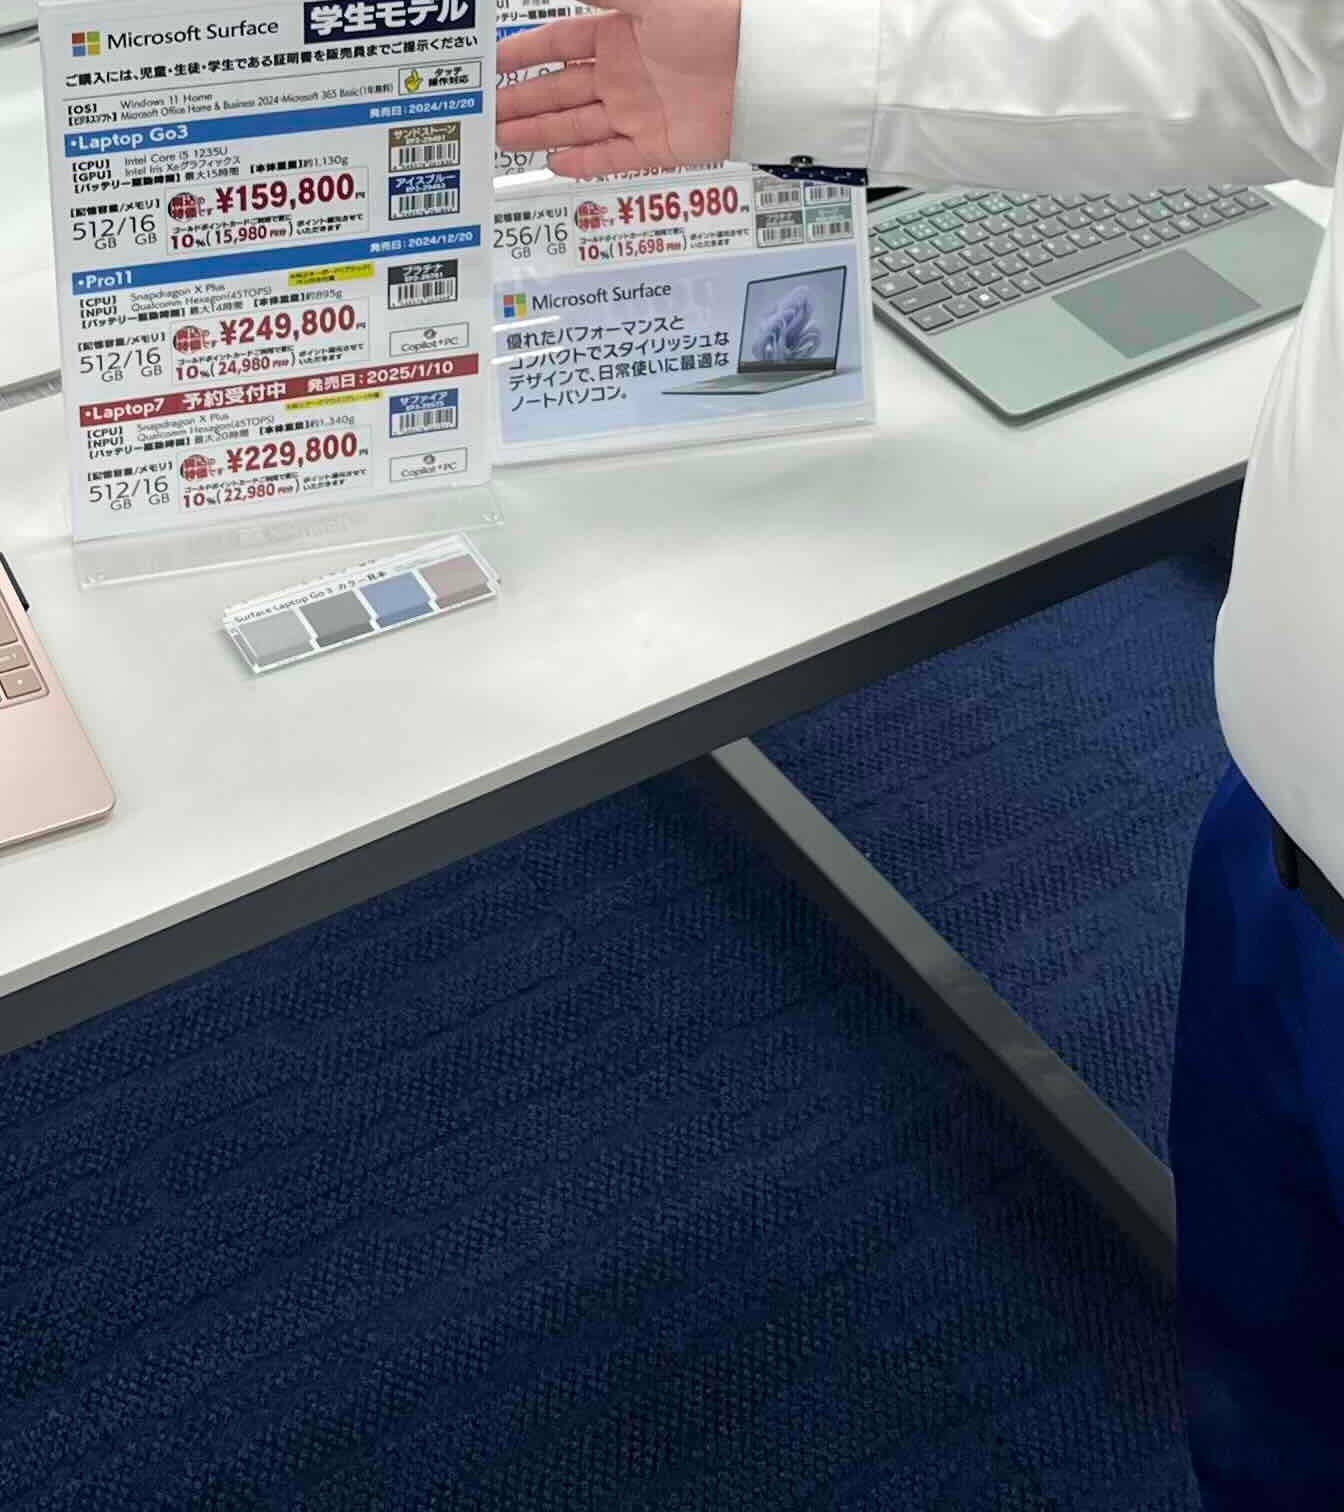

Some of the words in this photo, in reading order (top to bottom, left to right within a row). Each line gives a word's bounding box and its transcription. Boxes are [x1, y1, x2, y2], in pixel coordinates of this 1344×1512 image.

[107, 25, 202, 50] Microsoft
[207, 20, 279, 40] Surface
[120, 97, 165, 110] Windows
[169, 95, 179, 105] 11
[183, 92, 213, 104] Home
[150, 125, 189, 142] Go3
[216, 172, 355, 214] ¥159,800
[617, 185, 739, 224] ¥156,980
[94, 238, 117, 250] GB
[135, 233, 157, 245] GB
[531, 289, 610, 312] Microsoft
[612, 283, 672, 303] Surface
[220, 304, 355, 346] ¥249,800
[506, 315, 685, 350] 優れたパフォーマンスと
[101, 371, 124, 383] GB
[141, 366, 162, 377] GB
[182, 383, 287, 411] 予約受付中
[226, 431, 358, 473] ¥229,800
[110, 500, 132, 511] GB
[149, 494, 170, 505] GB
